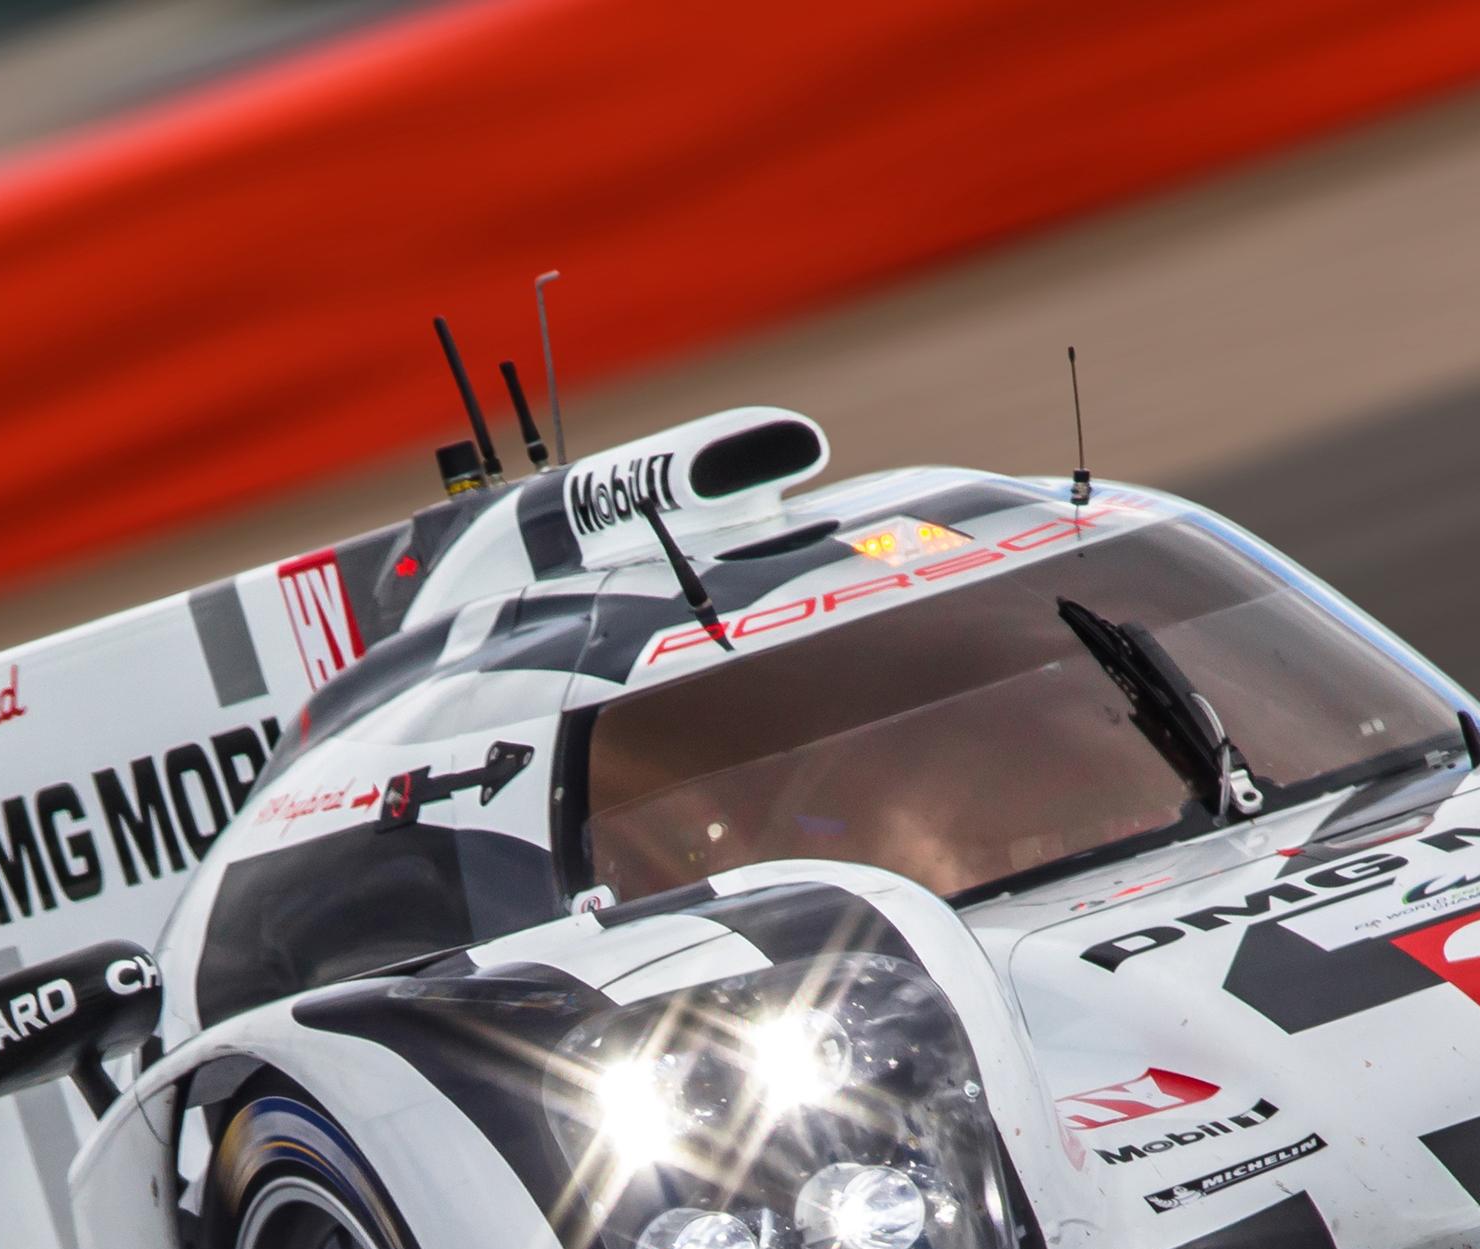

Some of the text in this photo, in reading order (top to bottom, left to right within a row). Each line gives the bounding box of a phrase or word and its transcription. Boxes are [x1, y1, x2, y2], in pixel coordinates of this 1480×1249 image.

[570, 457, 646, 535] Mobil
[1079, 853, 1408, 973] DMG
[1092, 1121, 1233, 1165] Mobil
[1201, 1136, 1319, 1190] MICHELIN
